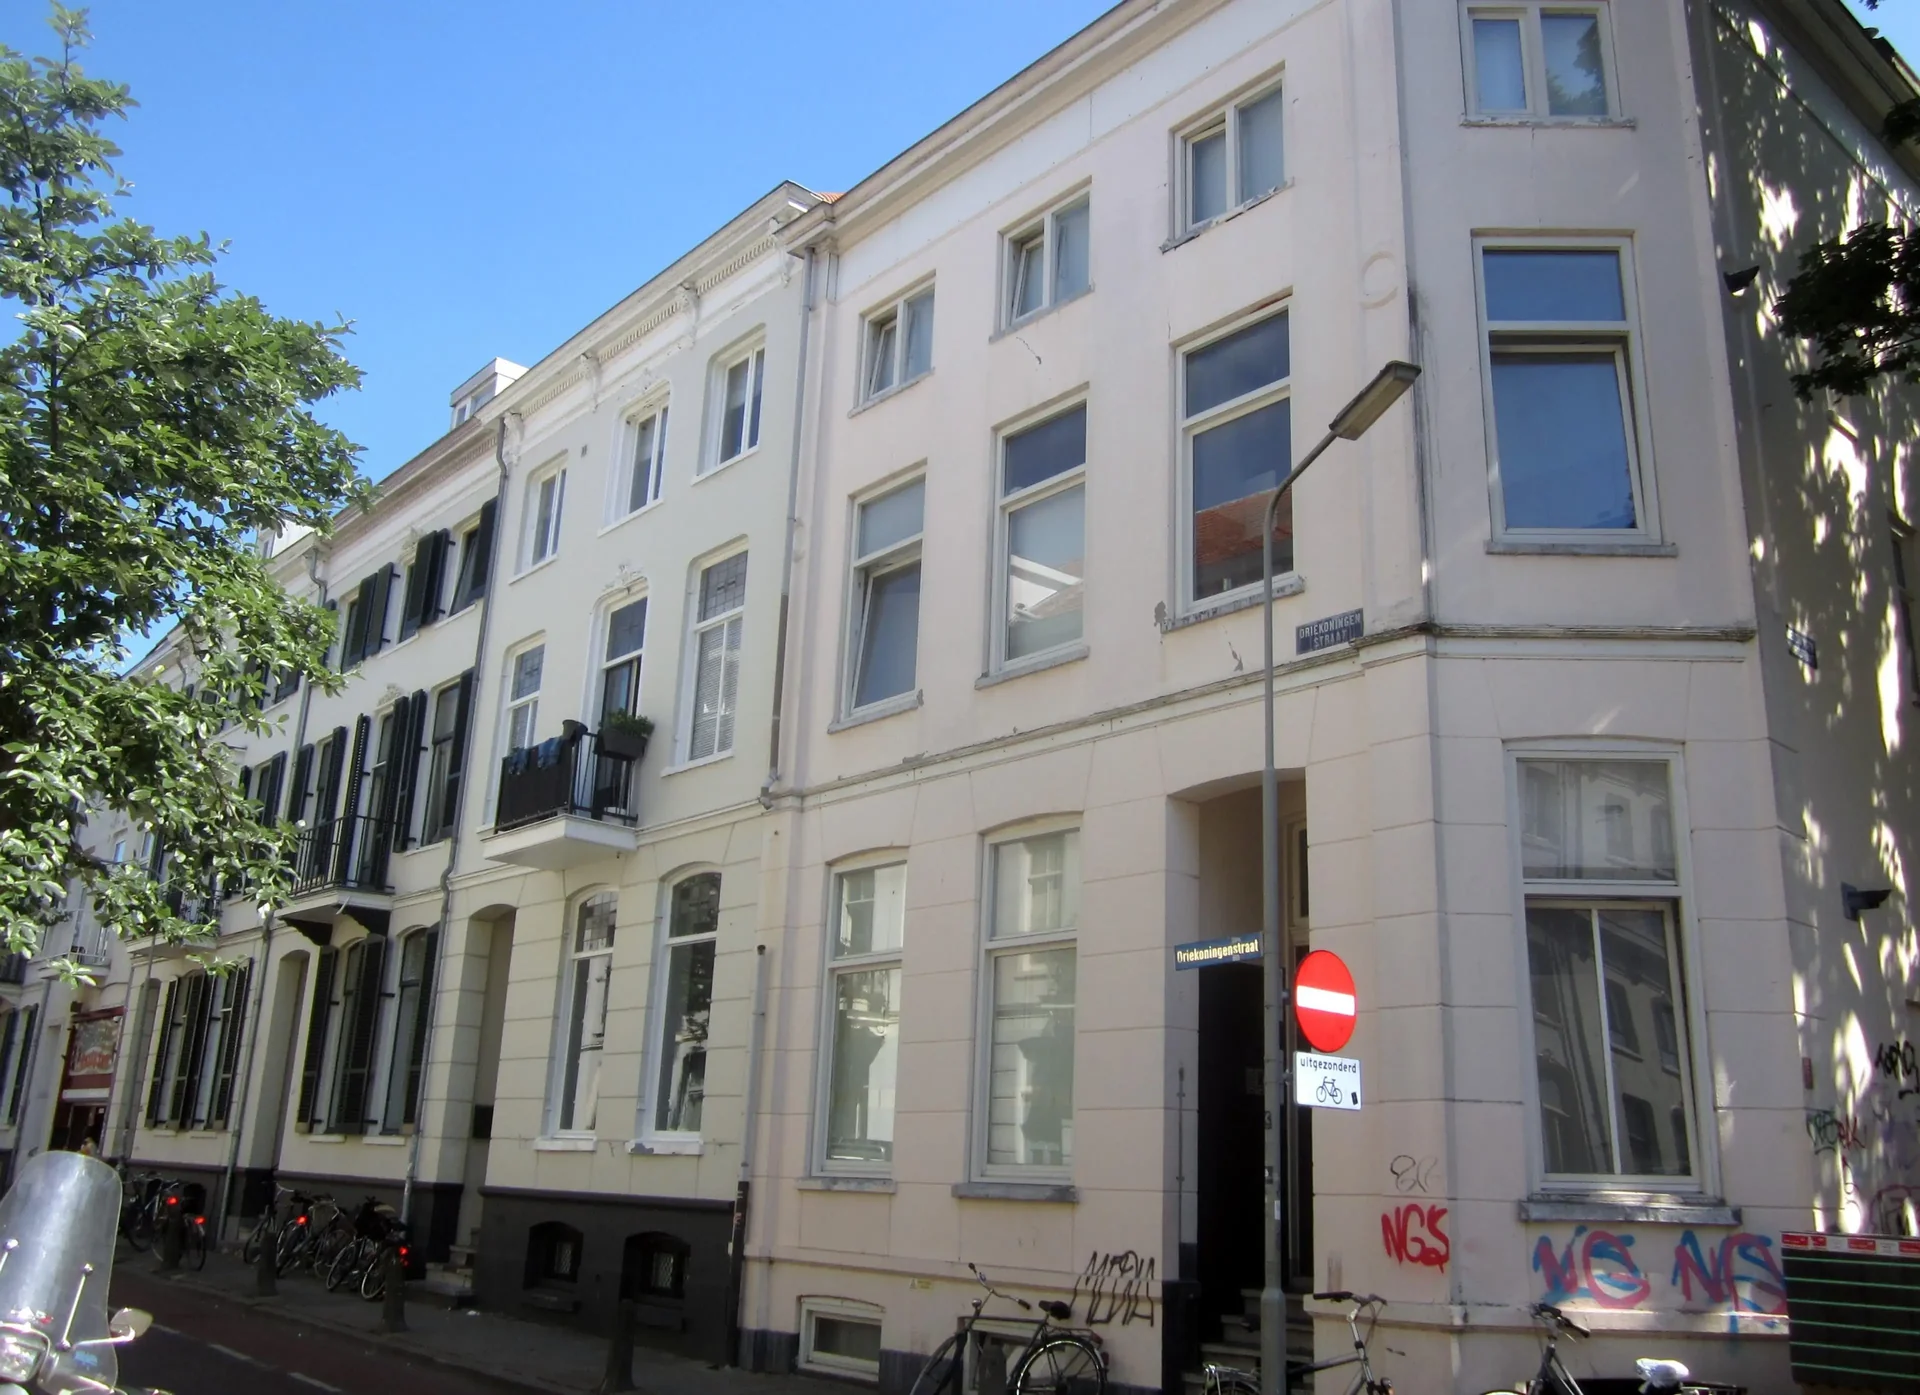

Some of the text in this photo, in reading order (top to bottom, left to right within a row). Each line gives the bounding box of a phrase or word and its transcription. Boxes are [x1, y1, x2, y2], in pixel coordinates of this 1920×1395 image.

[1299, 613, 1361, 639] DRIEKONINGEN
[1313, 630, 1348, 648] STRAAT
[1176, 939, 1259, 963] Driekoningenstraat
[1300, 1056, 1357, 1073] uitgezonderd
